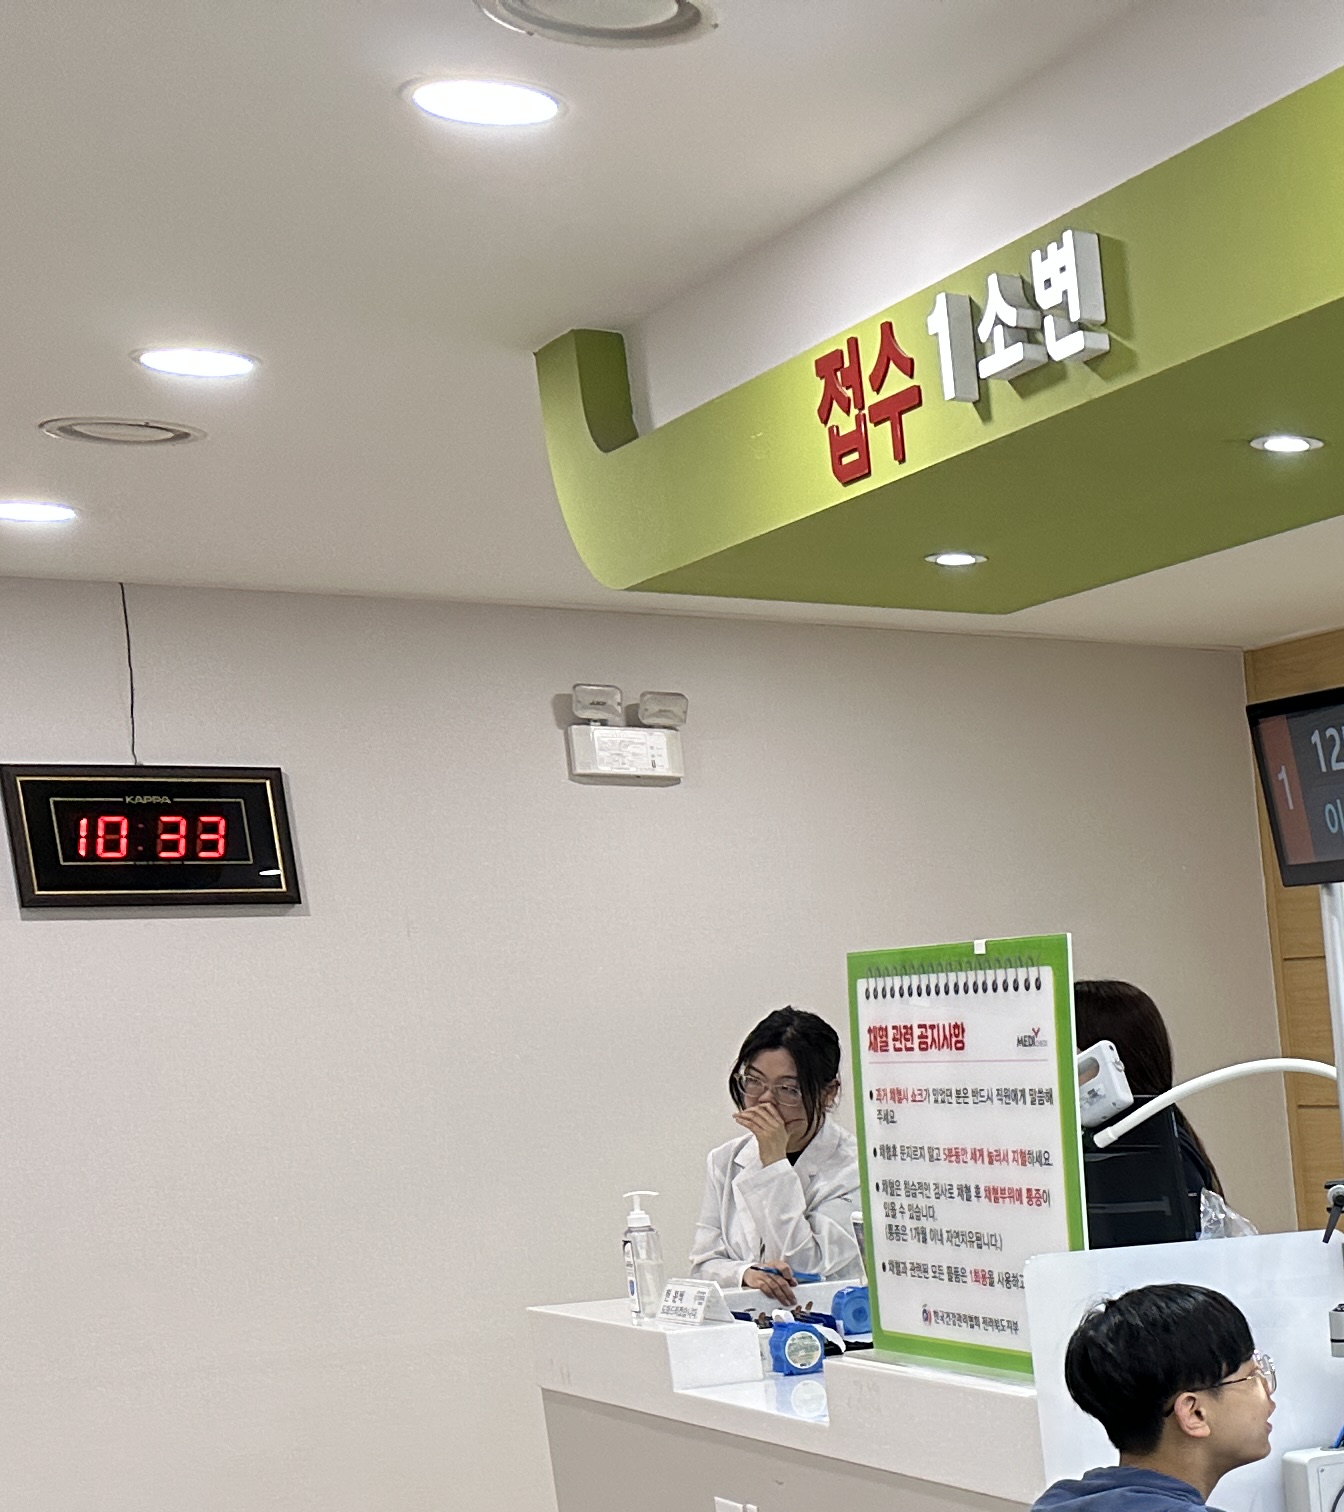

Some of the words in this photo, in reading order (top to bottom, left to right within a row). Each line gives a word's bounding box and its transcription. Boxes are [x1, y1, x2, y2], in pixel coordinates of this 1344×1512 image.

[815, 321, 922, 487] 접수
[1278, 764, 1295, 810] 1
[125, 795, 172, 804] KAPPA
[867, 1024, 890, 1053] 채혈
[891, 1023, 915, 1053] 관련
[917, 1021, 966, 1052] 공지사항
[910, 1088, 931, 1104] 쇼크가
[955, 1087, 970, 1104] 분은
[971, 1087, 993, 1104] 반드시
[996, 1087, 1027, 1105] 직원에게
[1025, 1187, 1051, 1209] 통증이
[898, 1203, 906, 1219] 수
[929, 1227, 944, 1246] 이내
[931, 1264, 945, 1281] 모든
